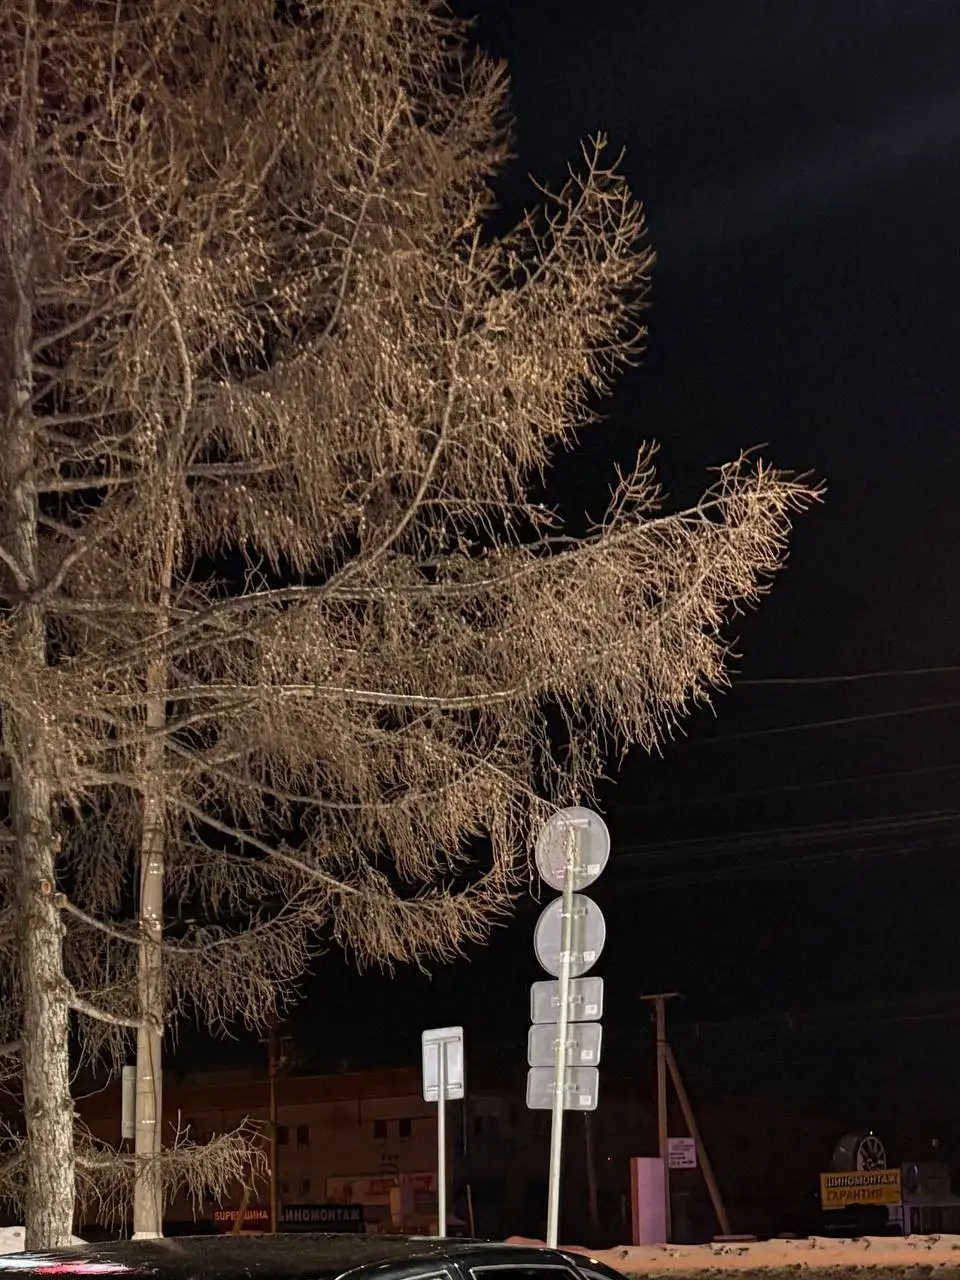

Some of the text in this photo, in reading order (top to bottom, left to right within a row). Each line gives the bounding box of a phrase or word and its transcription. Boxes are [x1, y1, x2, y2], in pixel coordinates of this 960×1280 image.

[825, 1173, 897, 1187] ШИНОМОНТАЖ
[214, 1210, 240, 1221] SUPE
[280, 1207, 360, 1222] ИНОМОНТАЖ
